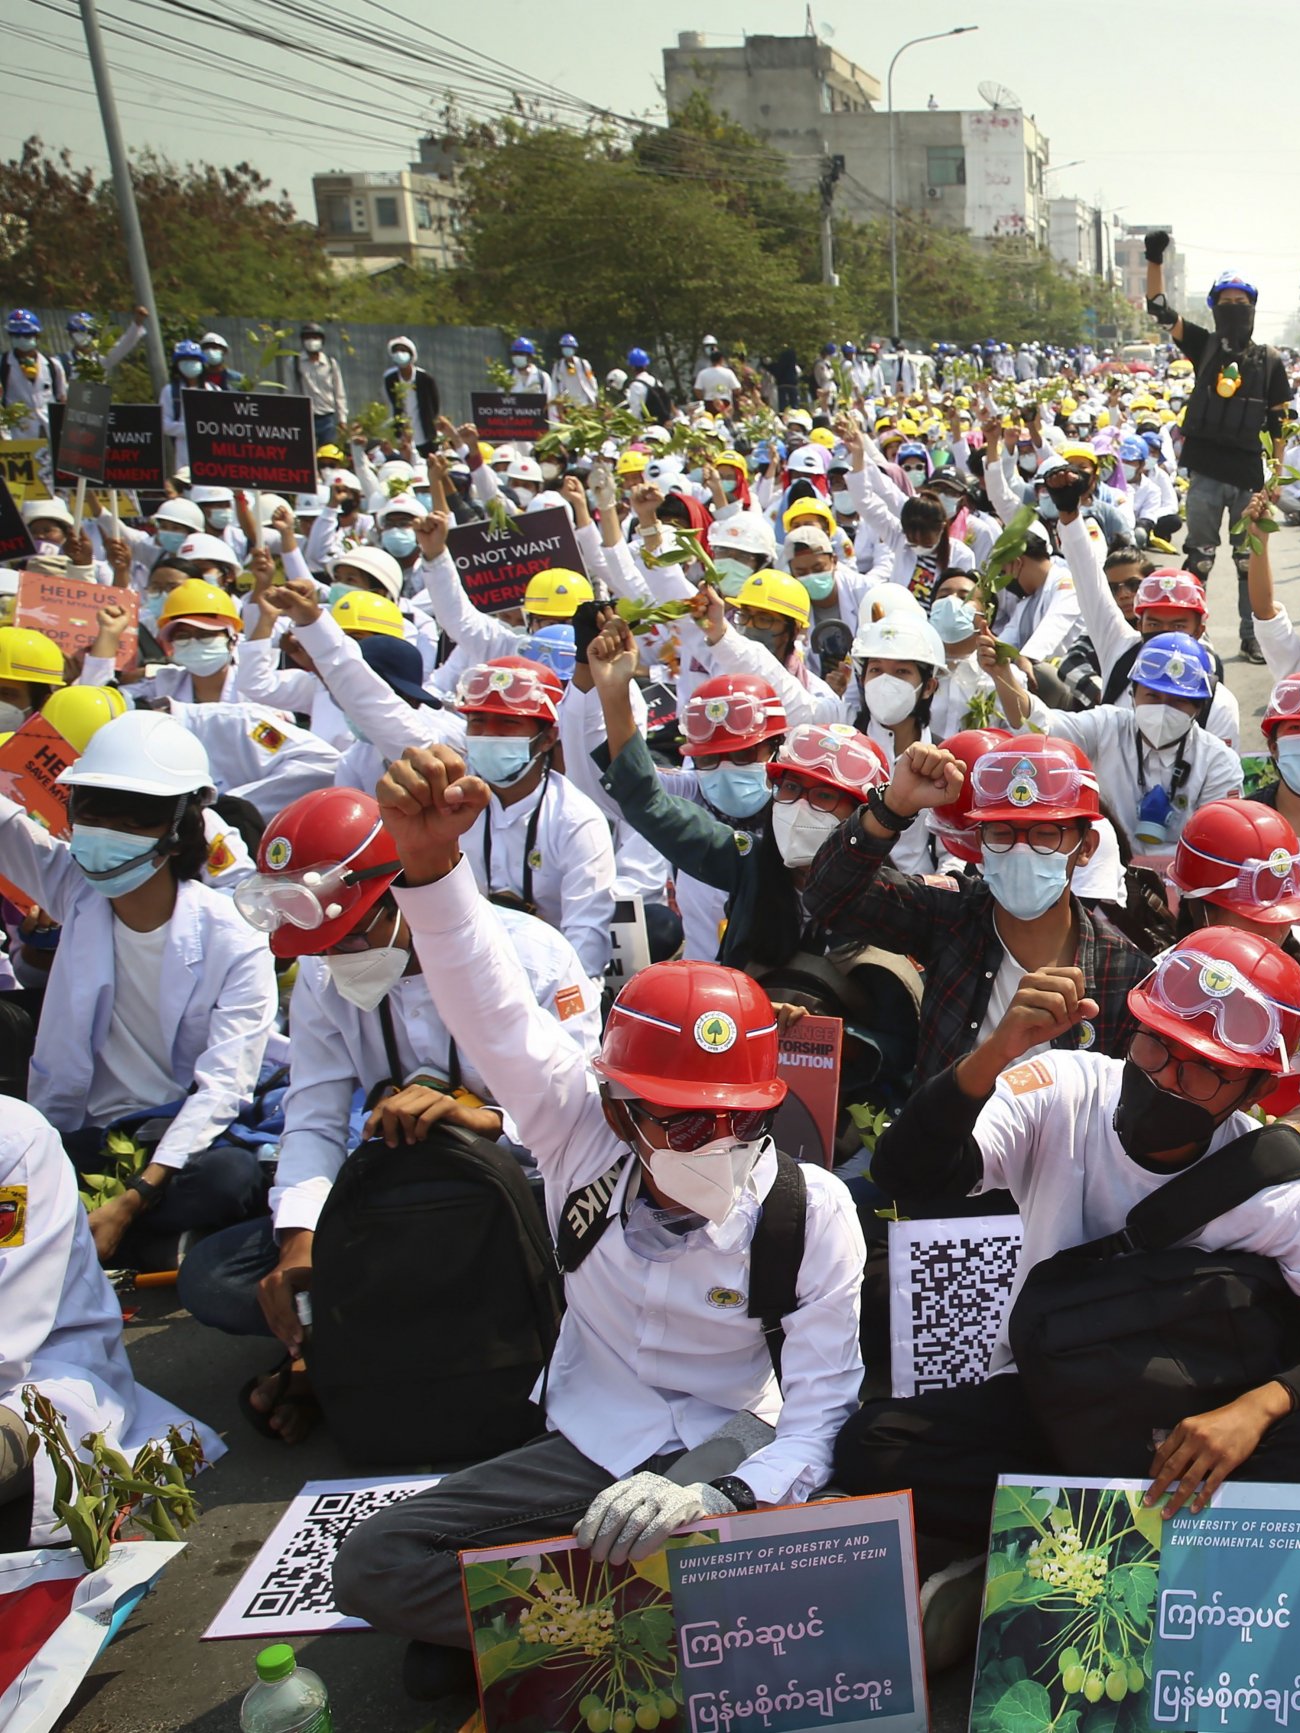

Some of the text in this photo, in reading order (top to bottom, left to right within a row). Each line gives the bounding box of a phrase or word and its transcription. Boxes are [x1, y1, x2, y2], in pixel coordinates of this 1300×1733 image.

[234, 402, 259, 417] WE
[478, 407, 542, 416] DO NOT WANT
[112, 432, 153, 444] WANT
[197, 421, 301, 441] DO NOT WANT
[212, 442, 288, 461] MILITARY
[193, 463, 311, 484] GOVERNMENT
[481, 528, 511, 543] WE
[472, 546, 507, 567] NOT
[510, 536, 561, 558] WANT
[465, 557, 550, 588] MILITARY
[41, 584, 117, 605] HELP US
[25, 761, 51, 787] SAVE
[1172, 1519, 1238, 1531] UNIVERSITY
[1241, 1521, 1256, 1531] OF
[680, 1535, 870, 1569] UNIVERSITY OF FORESTRY AND
[1171, 1535, 1265, 1548] ENVIRONMENTAL
[681, 1548, 888, 1584] ENVIRONMENTAL SCIENCE, YEZIN
[1159, 1590, 1291, 1642] ကြက်ဆူပင်
[681, 1606, 824, 1668] ကြက်ဆူပင်
